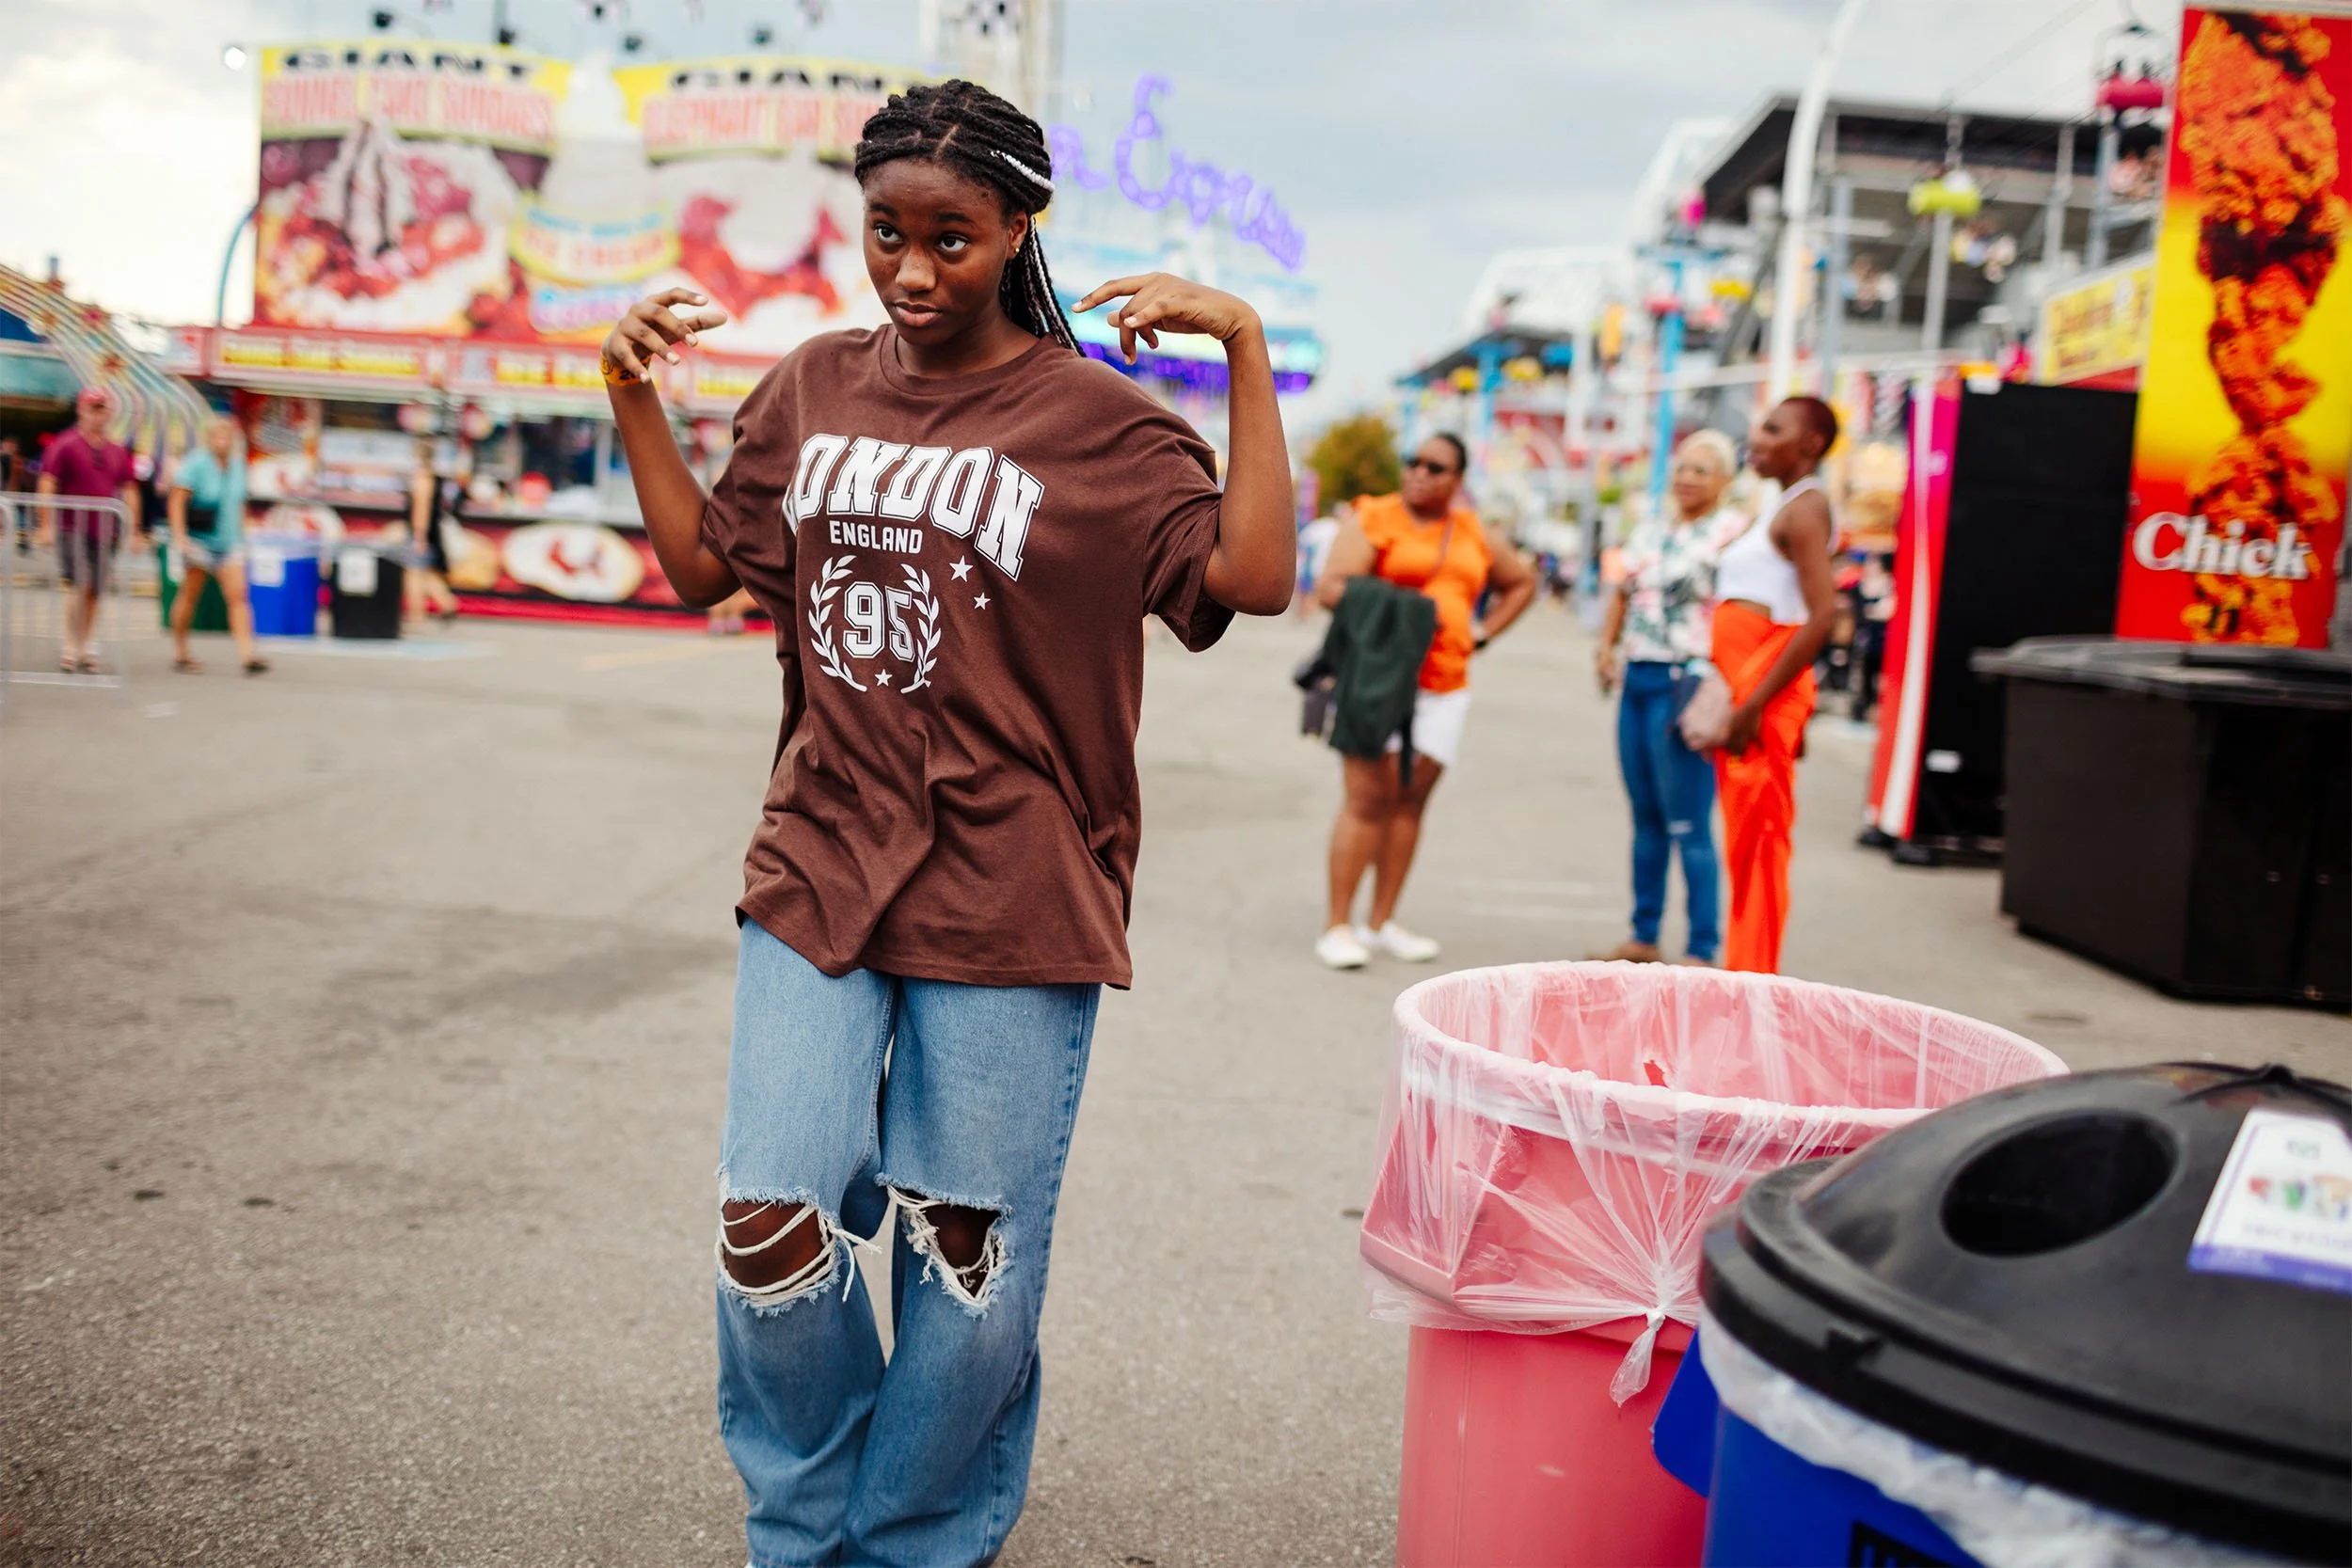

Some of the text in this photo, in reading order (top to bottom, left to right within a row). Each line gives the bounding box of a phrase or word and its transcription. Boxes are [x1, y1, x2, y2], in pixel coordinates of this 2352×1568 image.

[783, 433, 1045, 581] ONDON
[829, 520, 923, 553] ENGLAND
[2133, 512, 2312, 579] Chick
[843, 581, 914, 662] 95
